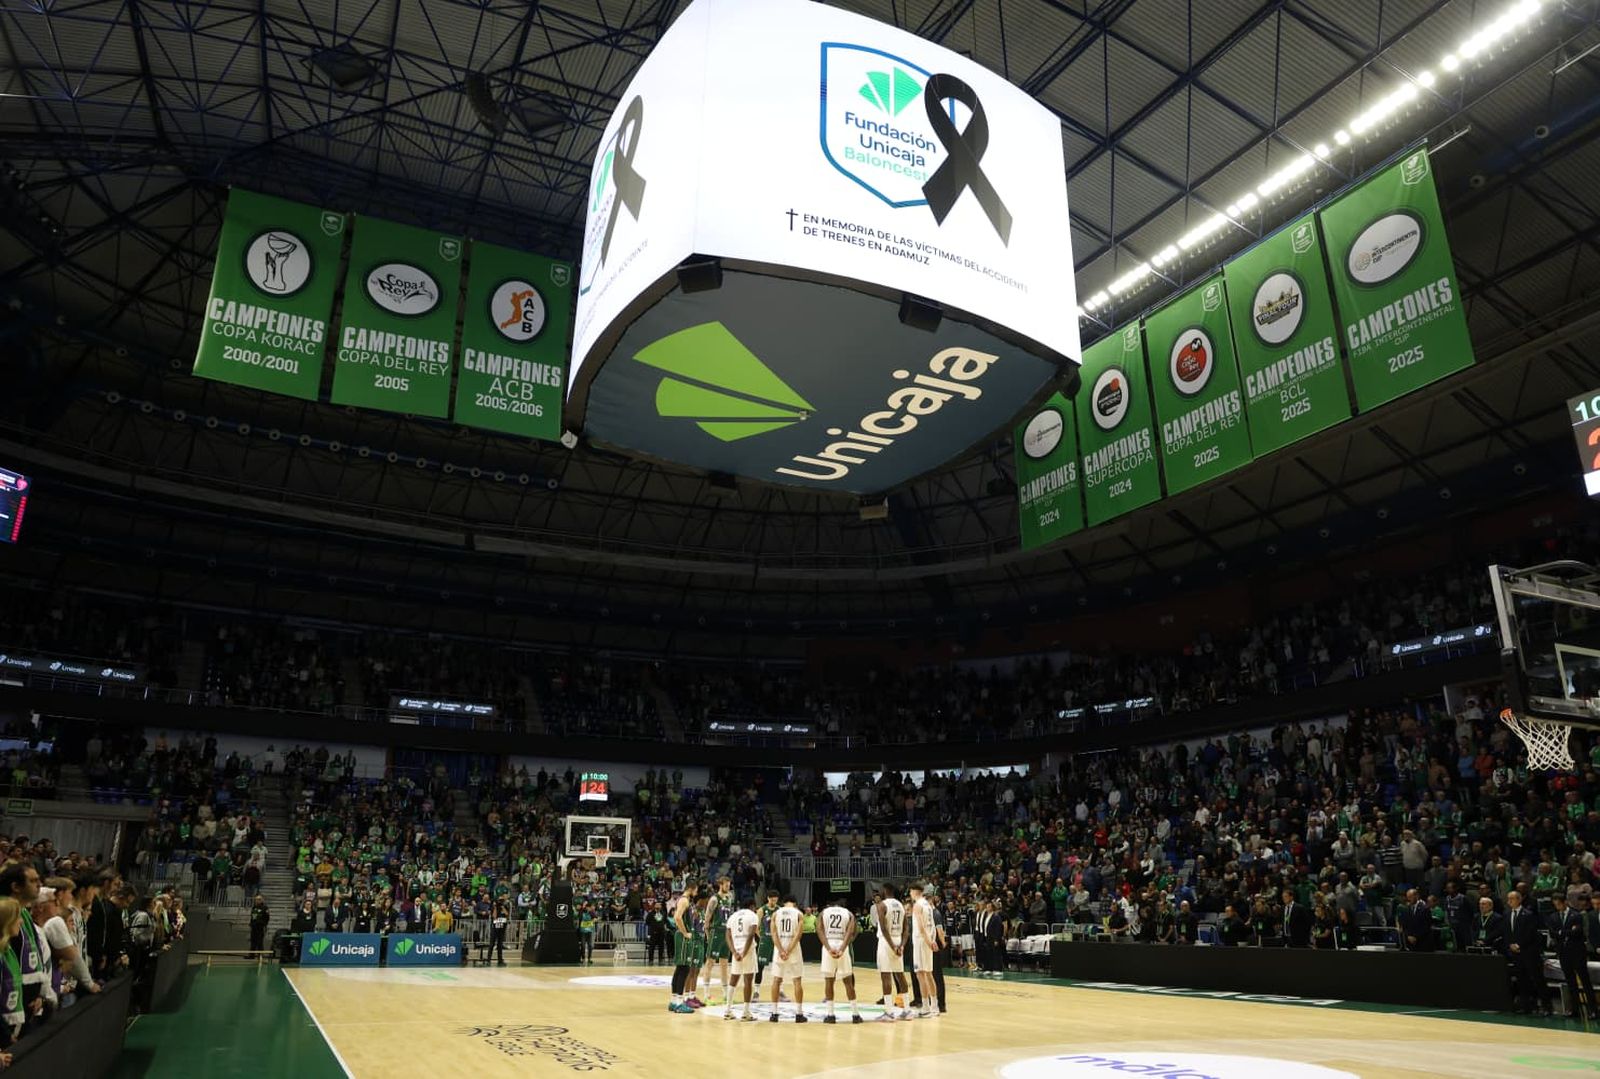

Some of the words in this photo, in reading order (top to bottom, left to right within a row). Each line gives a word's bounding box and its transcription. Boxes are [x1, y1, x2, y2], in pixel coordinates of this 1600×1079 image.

[845, 111, 937, 154] Fundación
[844, 146, 929, 182] Baloncest
[860, 133, 925, 167] Unicaja
[803, 213, 819, 224] EN
[822, 217, 875, 237] MEMORIA
[877, 230, 892, 241] DE
[893, 235, 914, 248] LAS
[964, 258, 982, 273] DEL
[803, 226, 818, 237] DE
[822, 229, 866, 247] TRENES
[868, 240, 882, 252] EN
[885, 245, 930, 266] ADAMUZ
[209, 297, 325, 342] CAMPEONES
[1347, 276, 1453, 350] CAMPEONES
[1375, 304, 1455, 347] INTERCONTINENTAL
[212, 322, 257, 342] COPA
[261, 332, 316, 355] KORAC
[343, 326, 449, 363] CAMPEONES
[1394, 332, 1410, 345] CUP
[223, 345, 299, 374] 2000/2001
[339, 349, 380, 366] COPA
[384, 355, 414, 371] DEL
[419, 361, 449, 376] REY
[464, 348, 561, 388] CAMPEONES
[1246, 336, 1335, 398] CAMPEONES
[1388, 345, 1425, 373] 2025
[374, 374, 410, 391] 2005
[489, 378, 534, 400] ACB
[1280, 383, 1306, 404] BCL
[475, 393, 543, 417] 2005/2006
[775, 346, 1000, 481] Unicaja
[1163, 390, 1240, 444] CAMPEONES
[1281, 397, 1312, 422] 2025
[1166, 437, 1193, 455] COPA
[1196, 426, 1217, 442] DEL
[1220, 412, 1242, 429] REY
[1084, 427, 1150, 475] CAMPEONES
[1194, 446, 1220, 468] 2025
[1020, 462, 1076, 504] CAMPEONES
[1086, 448, 1154, 488] SUPERCOPA
[1109, 478, 1132, 498] 2024
[1039, 508, 1060, 526] 2024
[590, 772, 608, 780] 10:00
[590, 782, 606, 794] 24
[738, 918, 744, 933] 5
[781, 918, 792, 932] 10
[829, 914, 842, 929] 22
[331, 944, 375, 957] Unicaja
[415, 944, 456, 957] Unicaja
